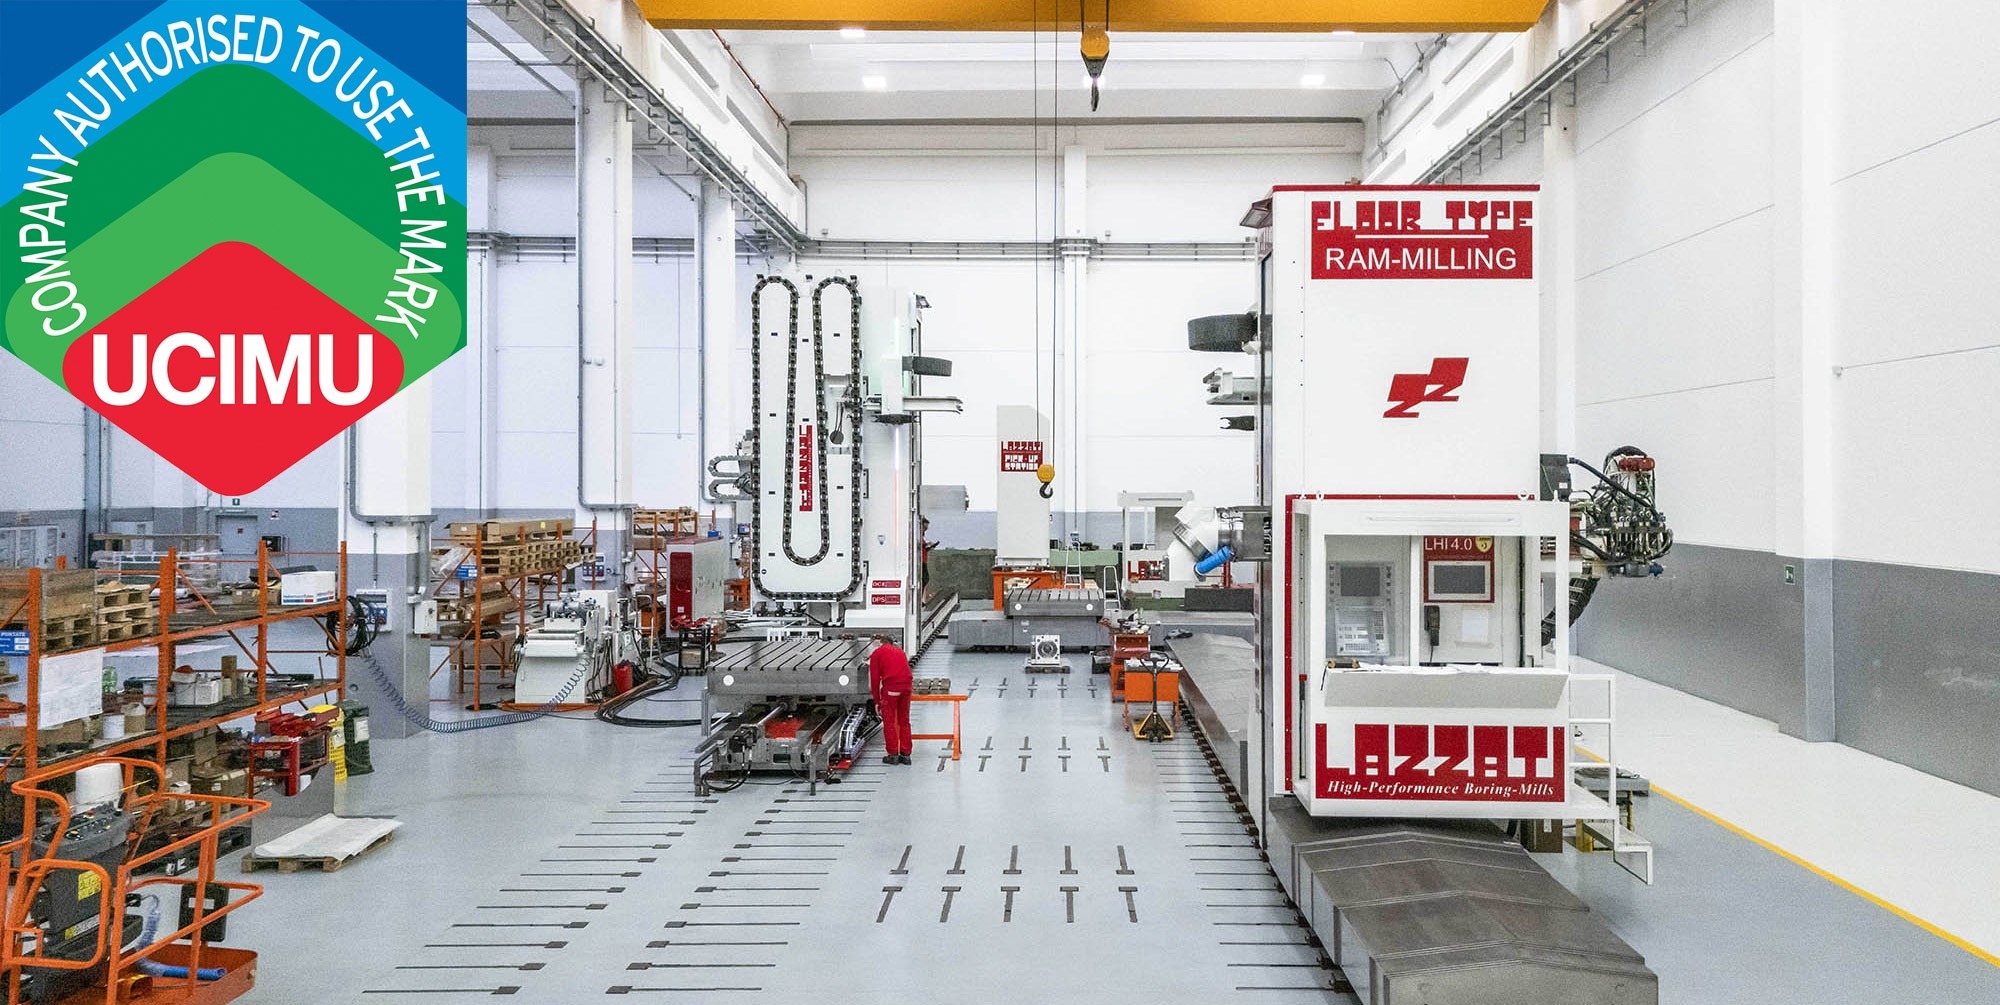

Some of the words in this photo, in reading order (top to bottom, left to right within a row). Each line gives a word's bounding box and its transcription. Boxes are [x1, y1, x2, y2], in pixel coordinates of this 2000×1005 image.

[1312, 201, 1422, 230] FLOOR
[1446, 201, 1533, 230] TYPE
[1325, 247, 1517, 271] RAM-MILLING
[1424, 538, 1448, 550] LHI
[1451, 538, 1473, 550] 4.0
[1326, 723, 1554, 778] LAZZATI
[1327, 780, 1459, 795] High-Performance
[1464, 782, 1554, 797] Boring-Mills
